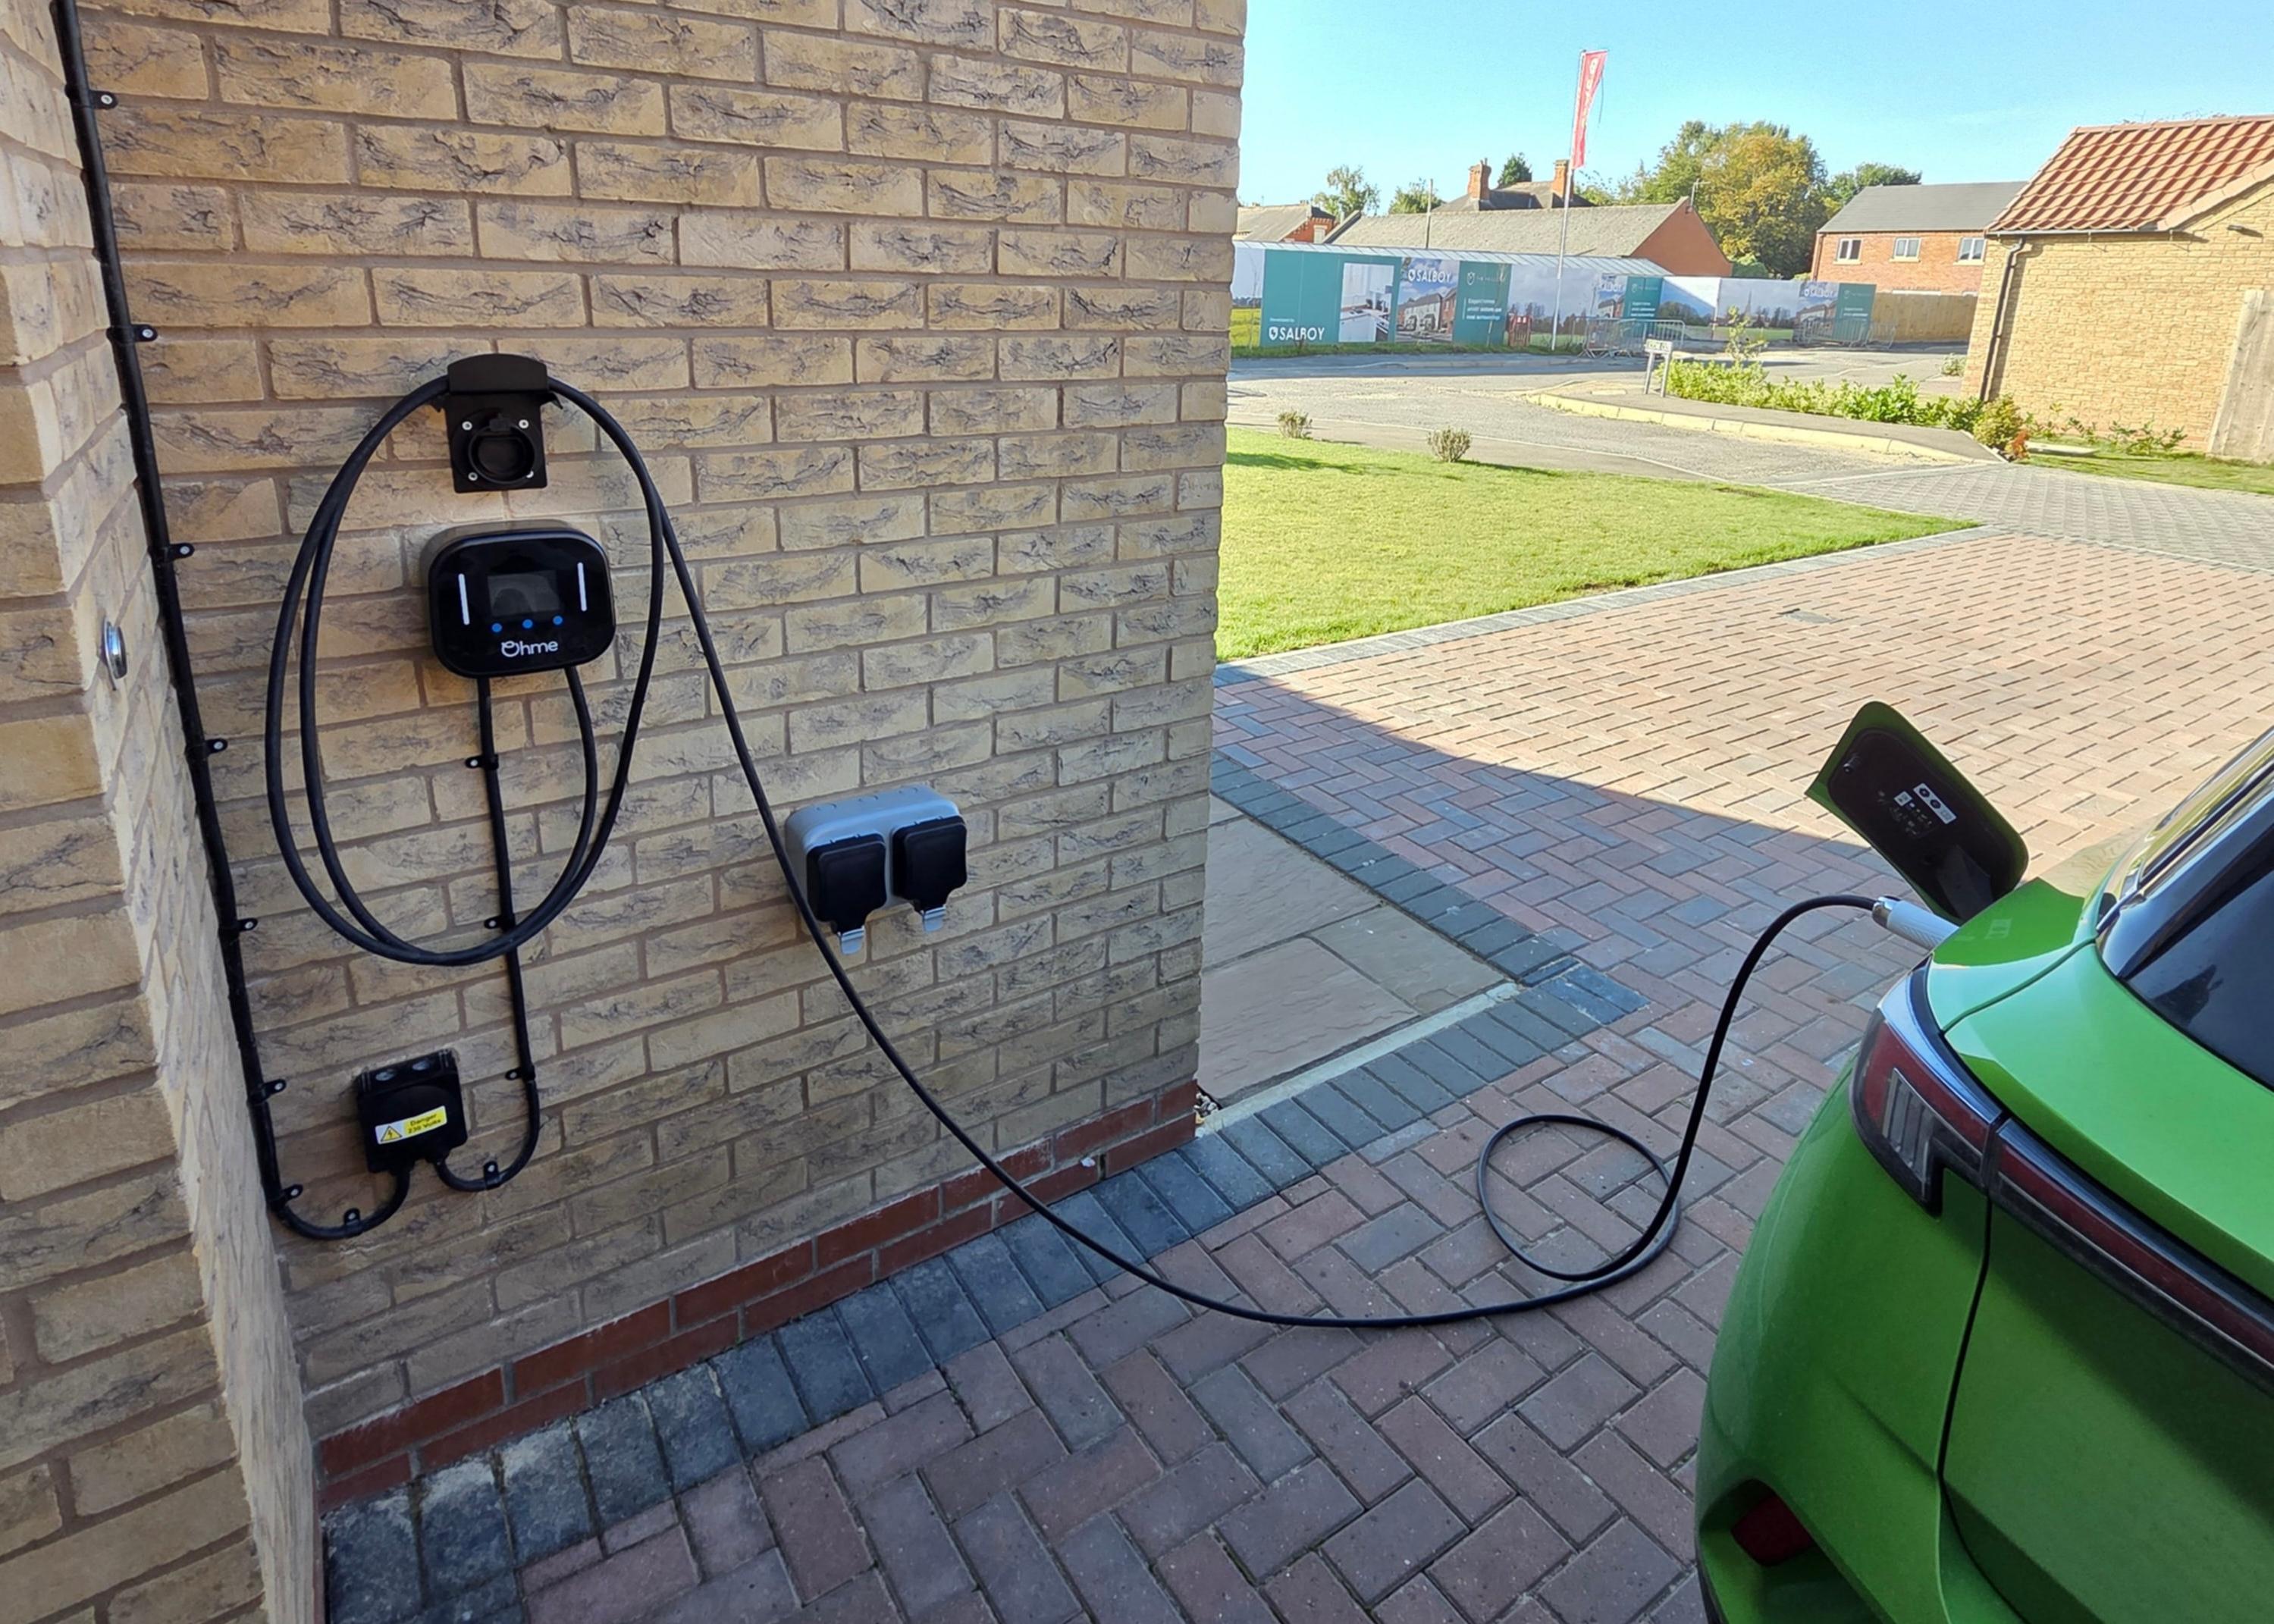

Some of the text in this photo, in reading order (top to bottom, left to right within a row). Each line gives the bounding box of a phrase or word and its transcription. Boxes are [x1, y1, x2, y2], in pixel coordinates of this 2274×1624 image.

[1416, 269, 1451, 283] SALBOY
[501, 640, 558, 657] Ohme
[410, 1114, 437, 1127] Danger
[408, 1125, 422, 1134] 230
